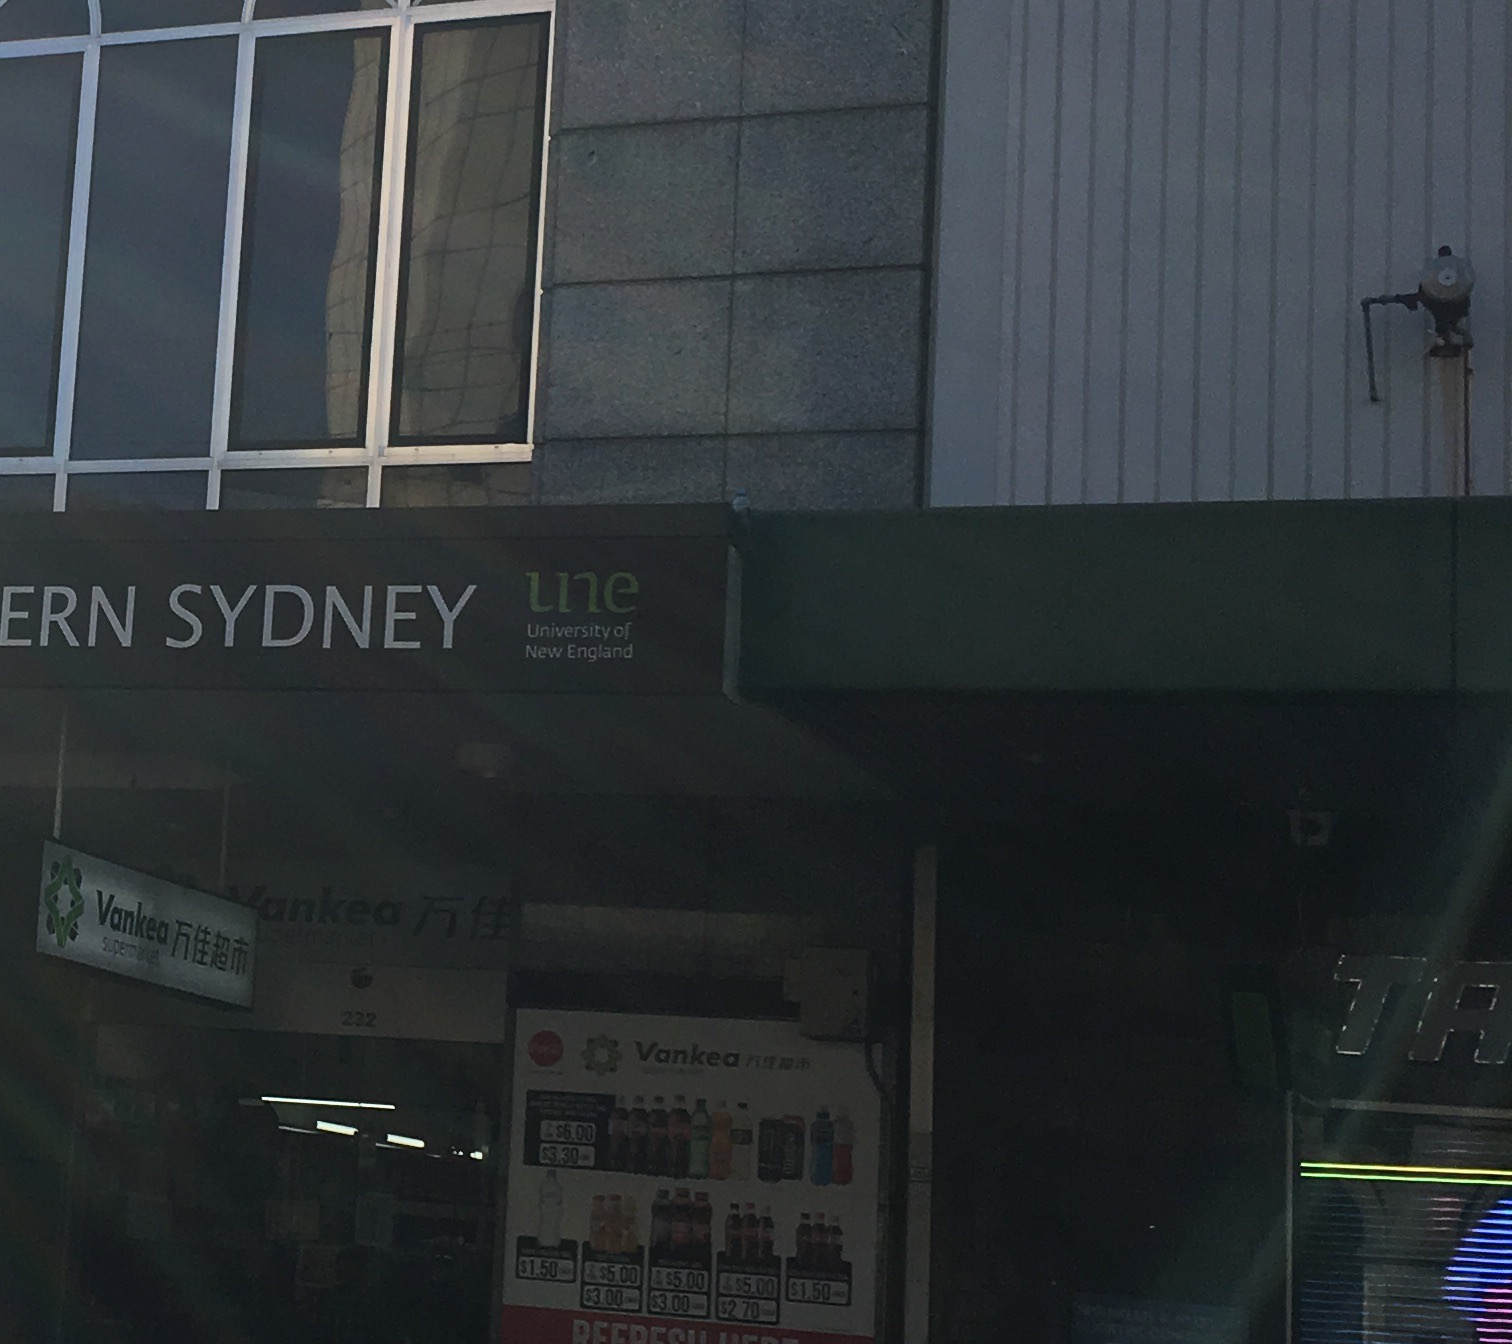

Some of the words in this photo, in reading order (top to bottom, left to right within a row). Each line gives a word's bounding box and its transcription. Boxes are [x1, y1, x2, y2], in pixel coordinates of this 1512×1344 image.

[524, 570, 640, 614] une
[164, 583, 478, 651] SYDNEY
[527, 622, 610, 641] University
[613, 622, 633, 640] of
[525, 644, 564, 658] New
[567, 643, 634, 663] England
[96, 889, 169, 945] Vankea
[170, 918, 250, 976] 万佳超市
[634, 1039, 741, 1069] Vankea
[555, 1122, 595, 1143] $6.00
[541, 1145, 580, 1165] $3.30
[519, 1257, 558, 1279] $1.50
[789, 1282, 832, 1301] $1.50
